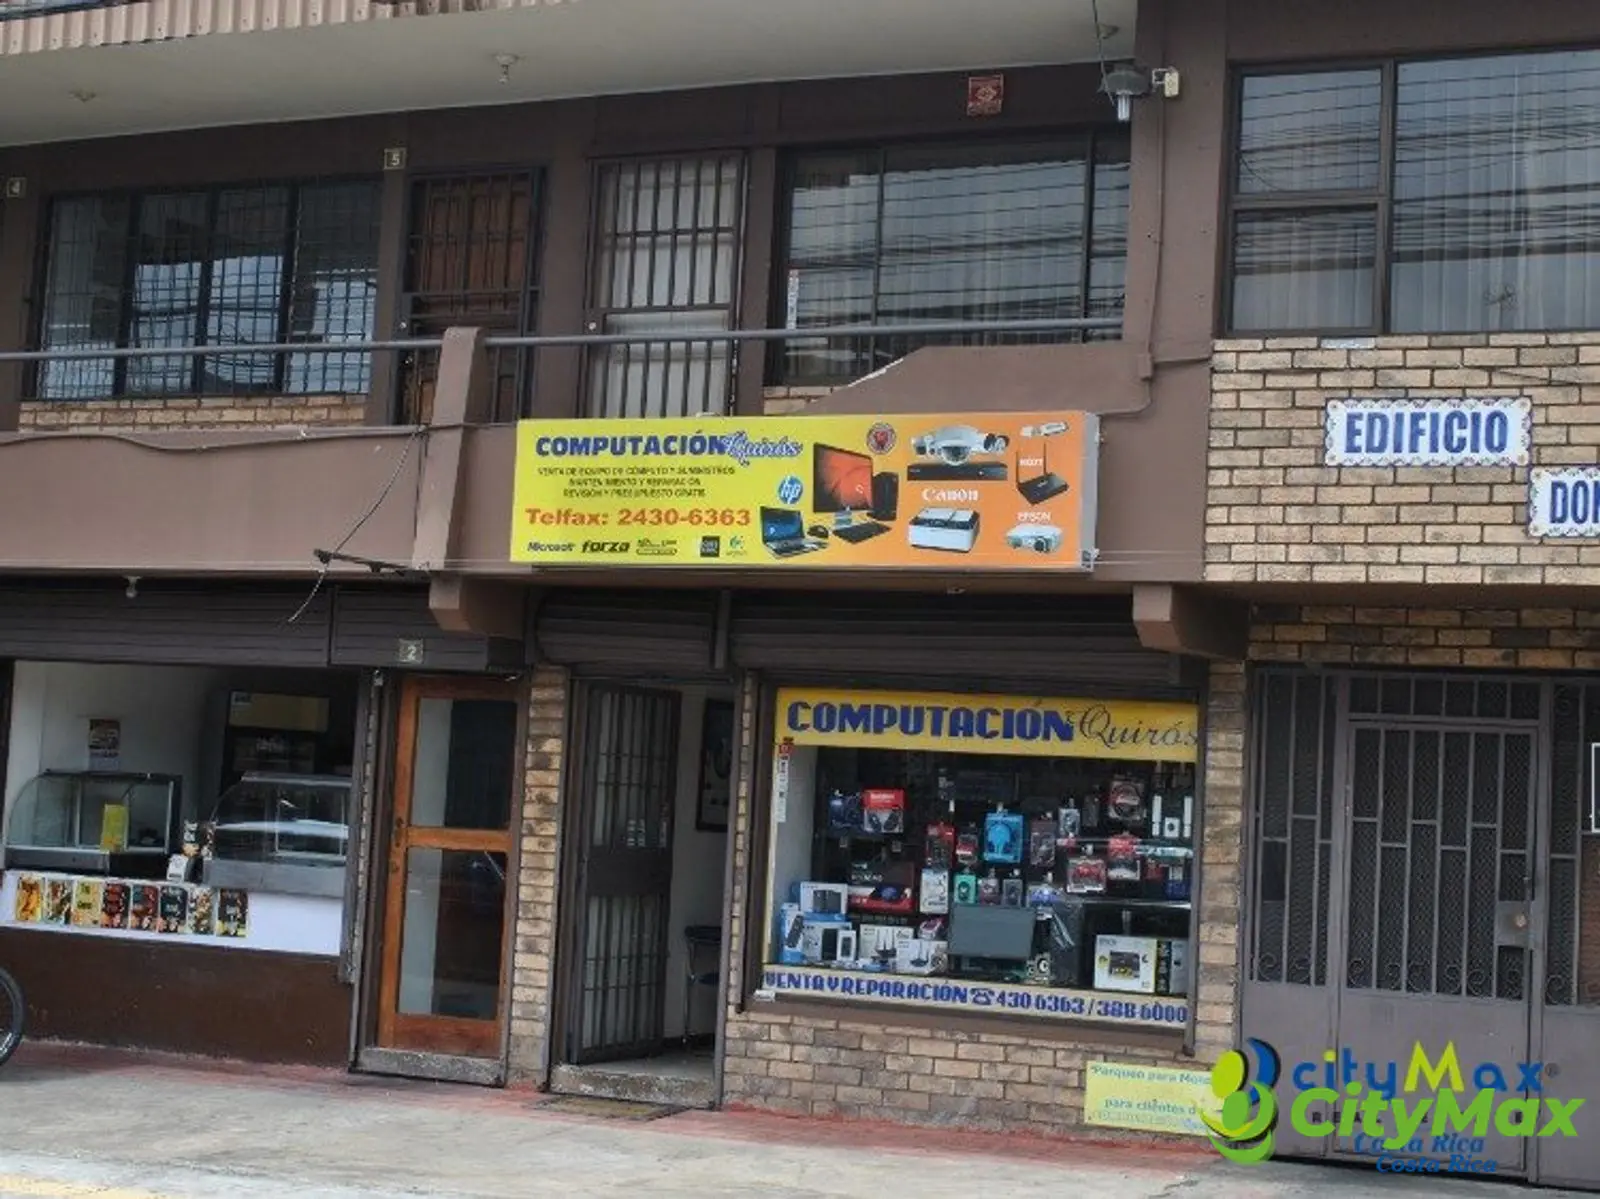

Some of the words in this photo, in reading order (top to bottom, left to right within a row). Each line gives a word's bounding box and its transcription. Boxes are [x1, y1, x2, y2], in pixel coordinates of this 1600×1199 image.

[1344, 410, 1509, 454] EDIFICIO
[535, 430, 727, 456] COMPUTACIÓN
[525, 507, 608, 526] Telfax:
[617, 507, 751, 526] 2430-6363
[527, 541, 575, 552] Microsoft
[582, 539, 630, 553] forza
[407, 645, 416, 660] 2
[787, 700, 1074, 742] COMPUTACIÓN
[765, 971, 825, 991] VENTA
